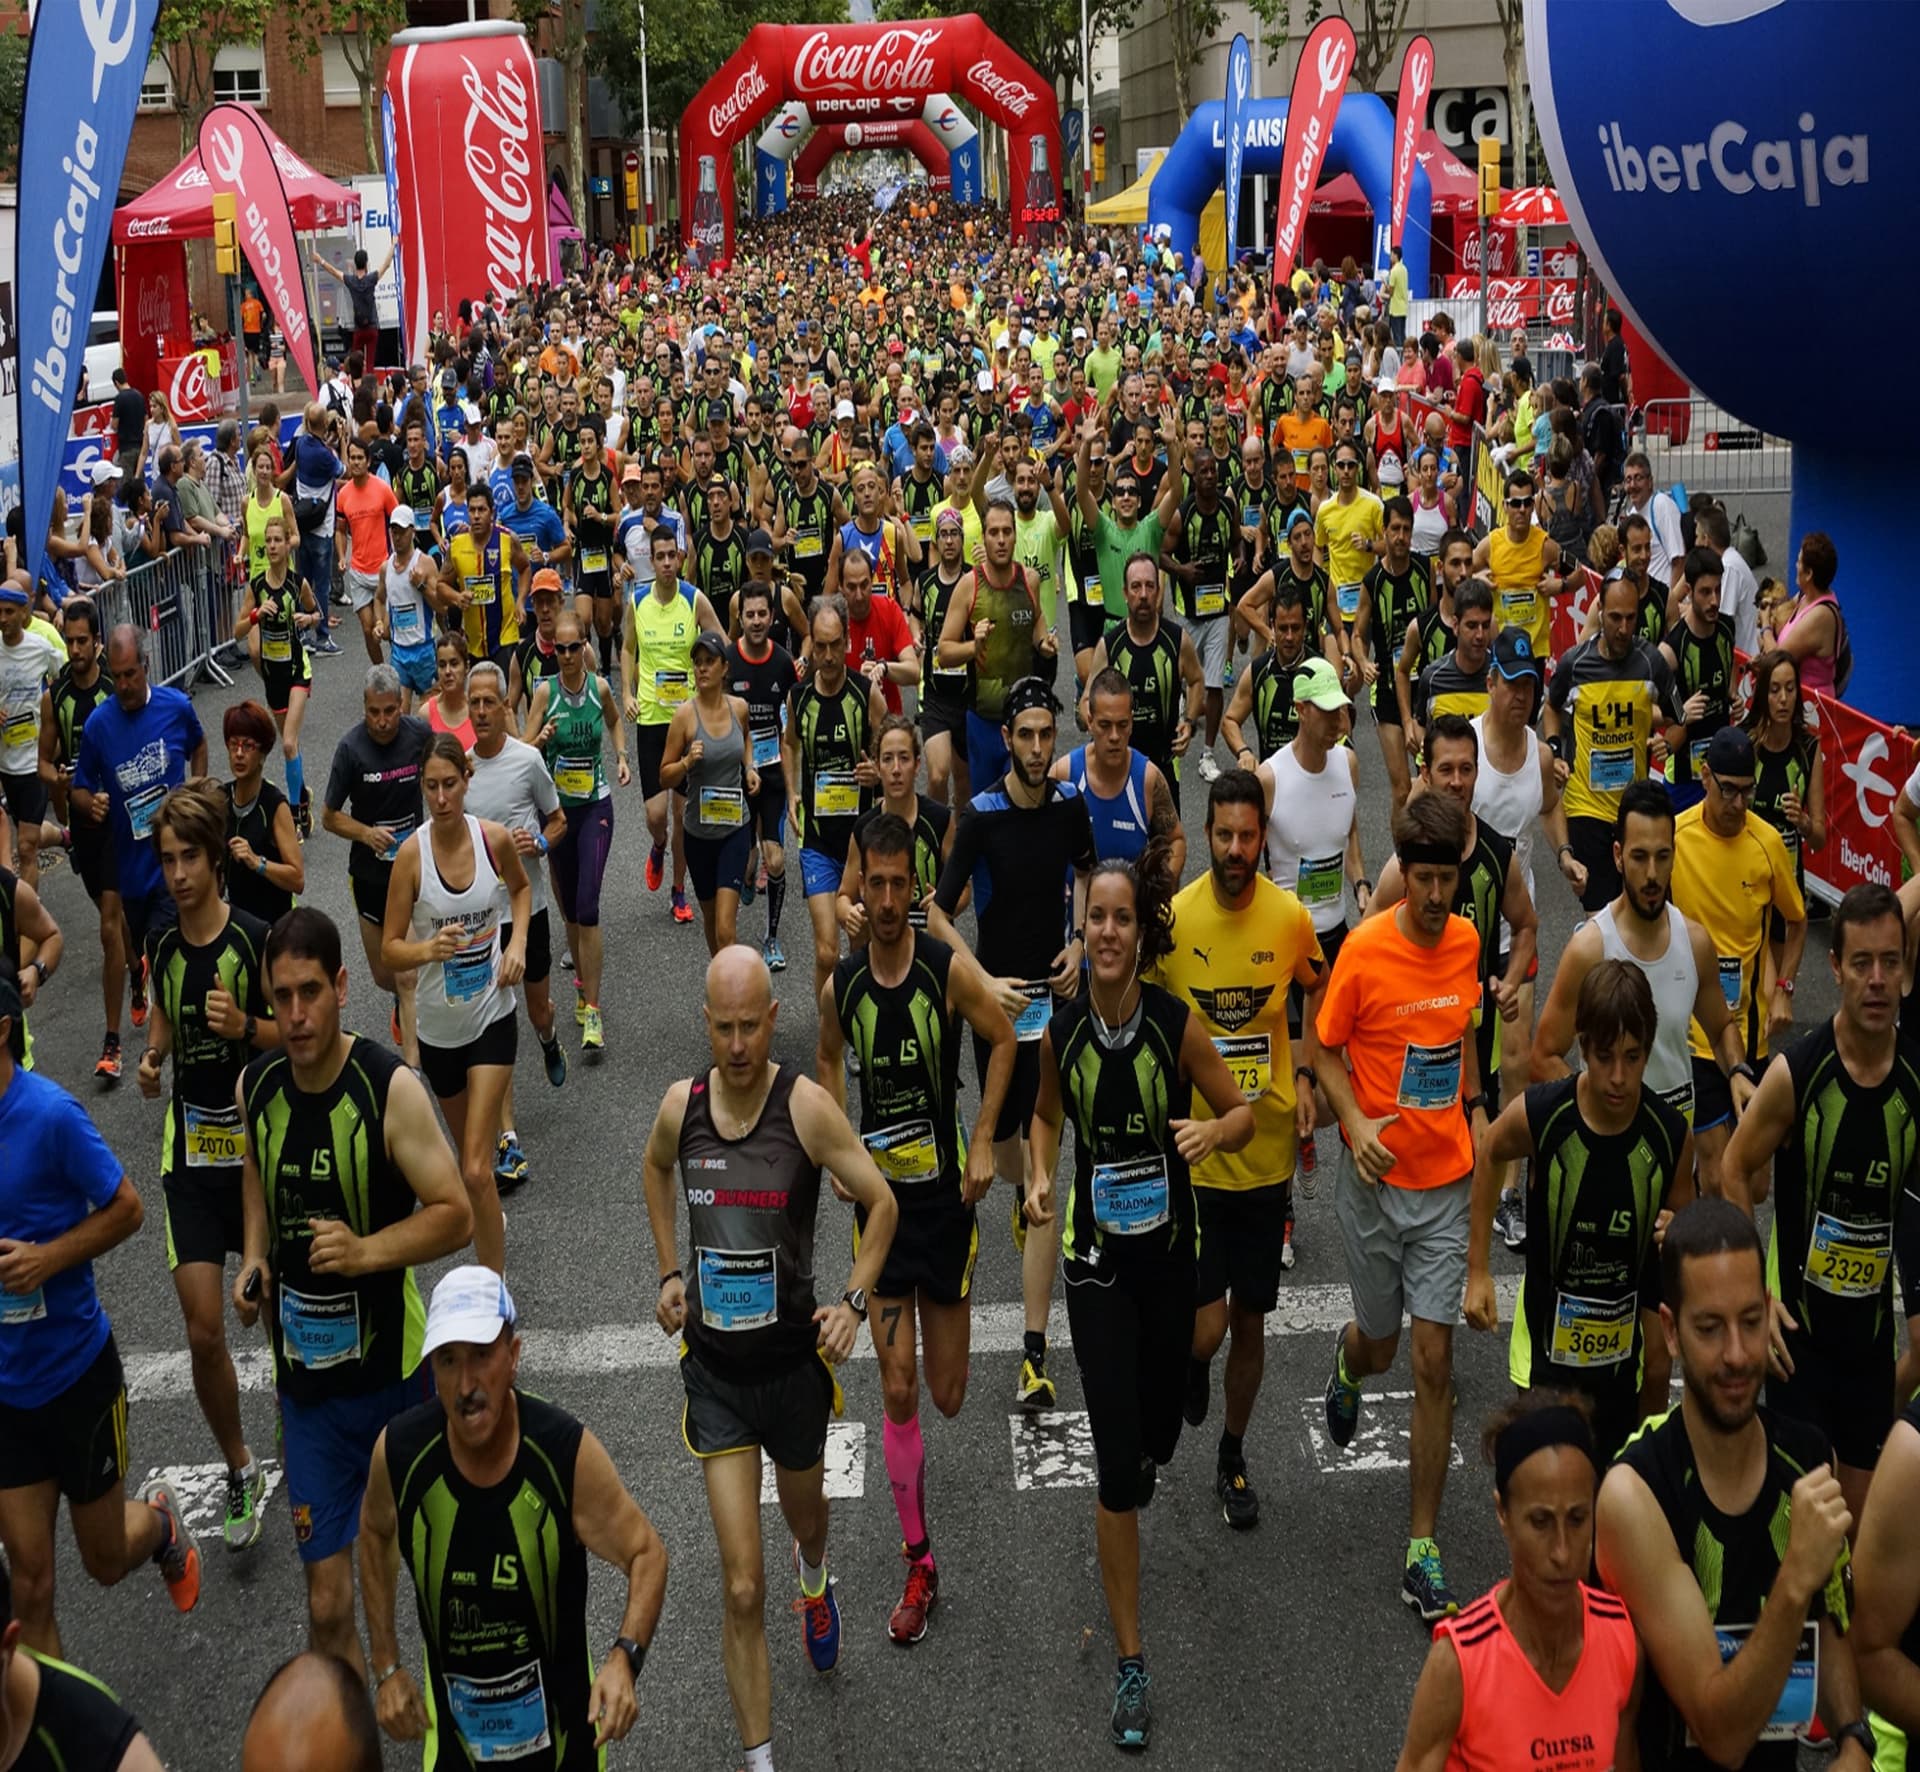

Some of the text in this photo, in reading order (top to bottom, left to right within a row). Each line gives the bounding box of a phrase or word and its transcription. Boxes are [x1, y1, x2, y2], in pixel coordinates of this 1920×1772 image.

[794, 29, 943, 92] Coca-Cola
[709, 58, 769, 137] Coca-Cola
[967, 60, 1038, 119] Coca-Cola
[1393, 115, 1415, 227] iberCaja
[1599, 113, 1868, 207] iberCaja
[1278, 115, 1320, 258] iberCaja
[31, 119, 100, 414] iberCaja
[1592, 702, 1634, 730] L'H
[1592, 730, 1634, 745] Runners
[1216, 991, 1251, 1010] 100%
[1216, 1008, 1251, 1022] RUNNING
[900, 1039, 918, 1061] LS
[1126, 1112, 1145, 1134] LS
[197, 1137, 236, 1156] 2070
[311, 1148, 331, 1176] LS
[1865, 1160, 1890, 1184] LS
[688, 1187, 789, 1209] PRORUNNERS
[1109, 1196, 1155, 1212] ARIADNA
[1608, 1210, 1632, 1233] LS
[1822, 1256, 1875, 1284] 2329
[720, 1291, 752, 1305] JULIO
[299, 1333, 335, 1345] SERGI
[1569, 1330, 1620, 1354] 3694
[492, 1553, 519, 1585] LS
[1530, 1734, 1595, 1761] Cursa
